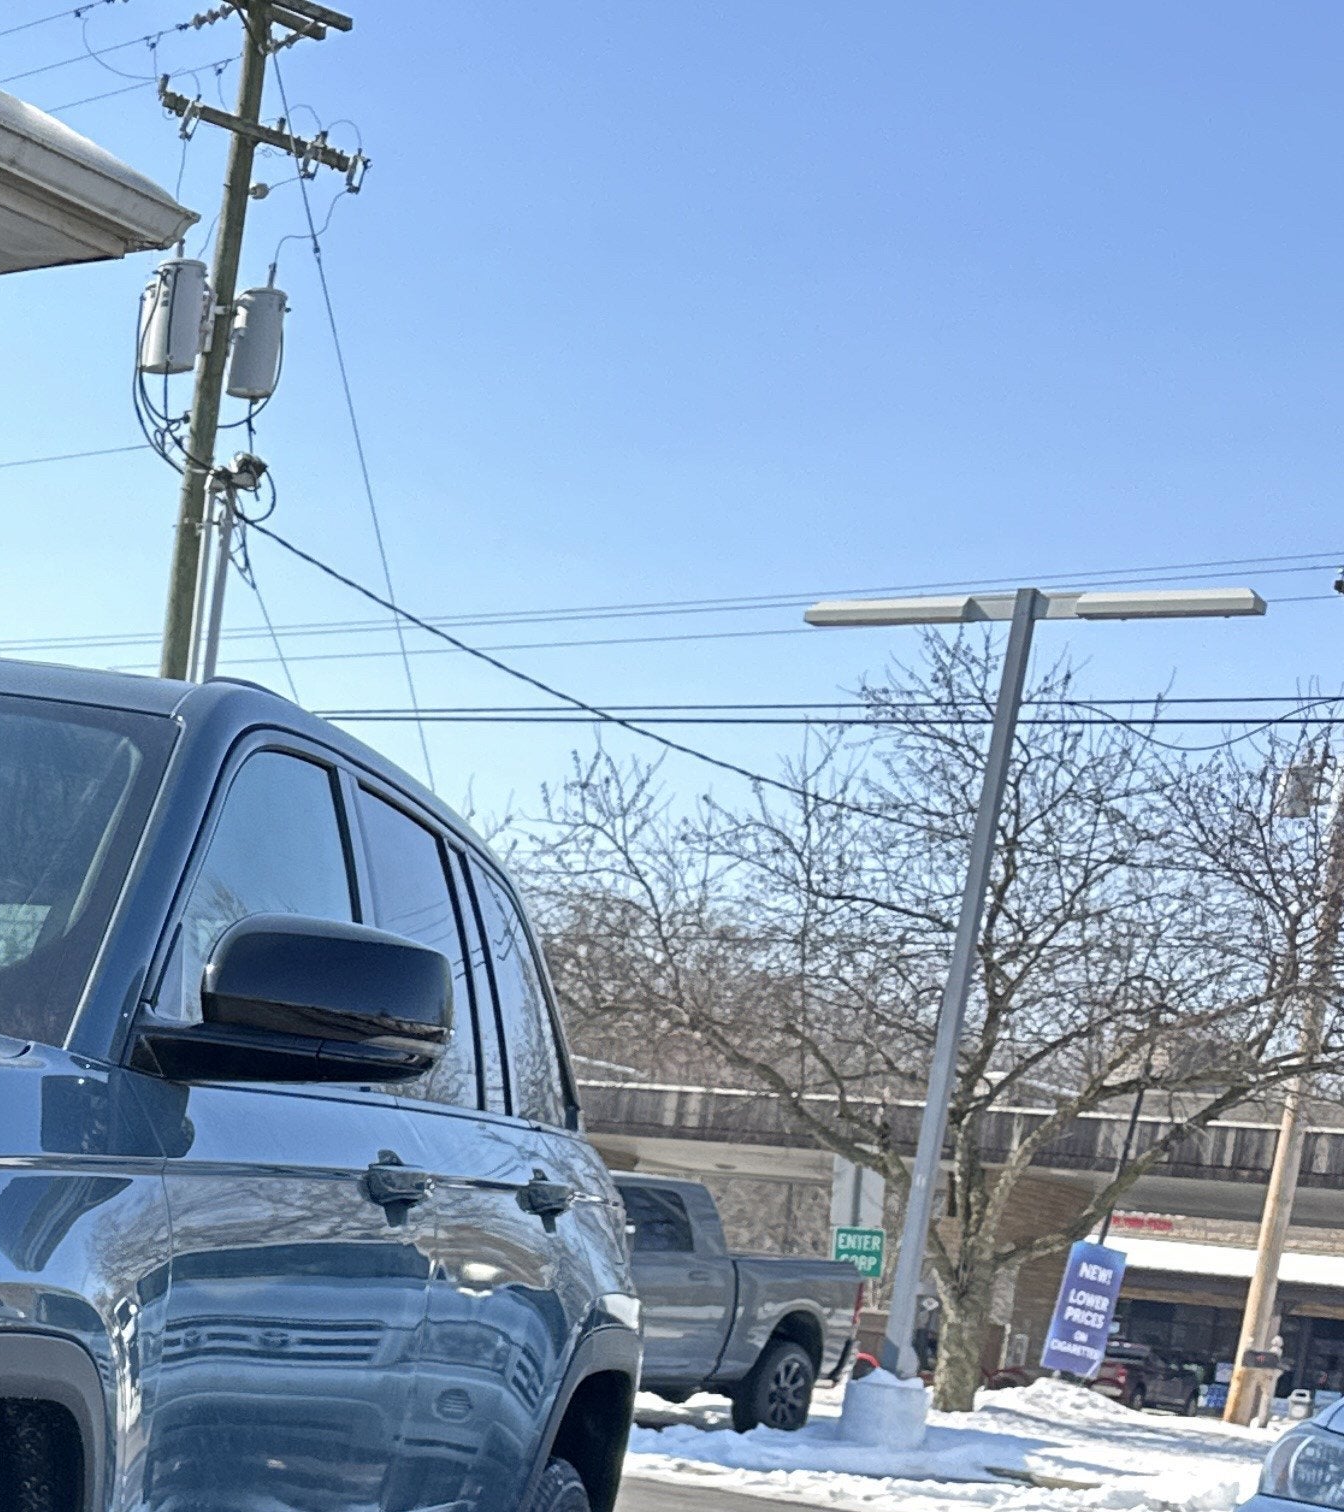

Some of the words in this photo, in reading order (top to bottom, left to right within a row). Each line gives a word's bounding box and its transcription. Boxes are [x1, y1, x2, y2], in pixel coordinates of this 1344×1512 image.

[837, 1232, 882, 1252] ENTER
[1078, 1261, 1114, 1286] NEW!
[1068, 1288, 1110, 1313] LOWER
[1063, 1305, 1106, 1330] PRICES
